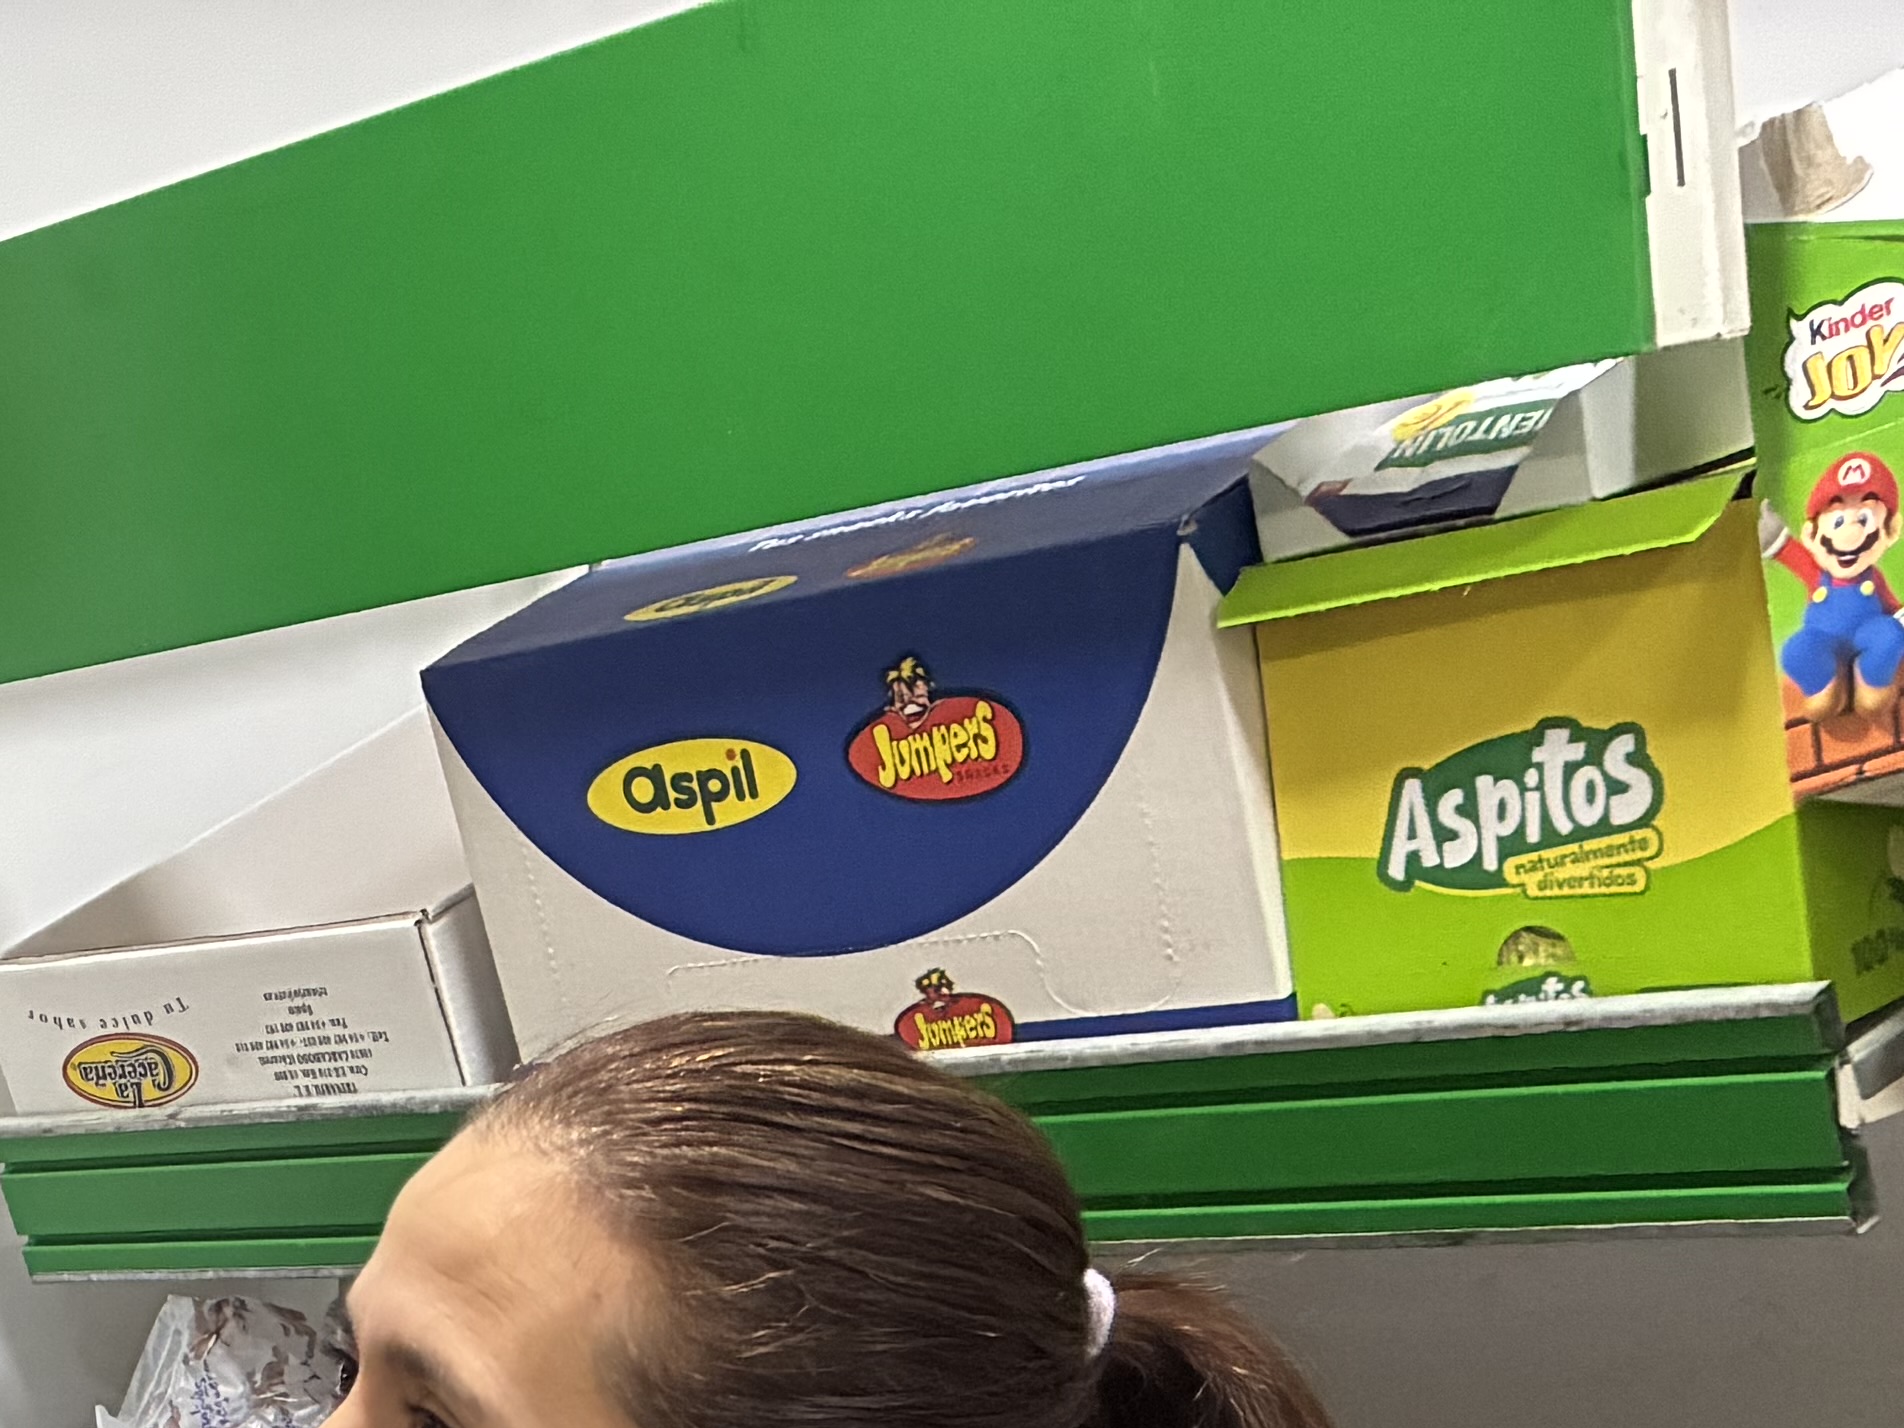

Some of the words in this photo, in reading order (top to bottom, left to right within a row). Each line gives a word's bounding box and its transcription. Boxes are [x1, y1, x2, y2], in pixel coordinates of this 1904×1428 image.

[1808, 297, 1895, 346] Kinder
[1802, 321, 1904, 411] JOY
[873, 700, 997, 788] Jumpers
[622, 747, 760, 826] aspil
[1386, 727, 1654, 881] Aspitos
[1513, 832, 1650, 878] naturalmente
[1536, 869, 1639, 892] divertidos
[27, 1010, 87, 1030] sabor
[99, 1010, 153, 1031] dulce
[163, 997, 190, 1015] Tu
[914, 1003, 996, 1049] Jumpers
[77, 1046, 175, 1093] Cacereña
[113, 1082, 146, 1108] La
